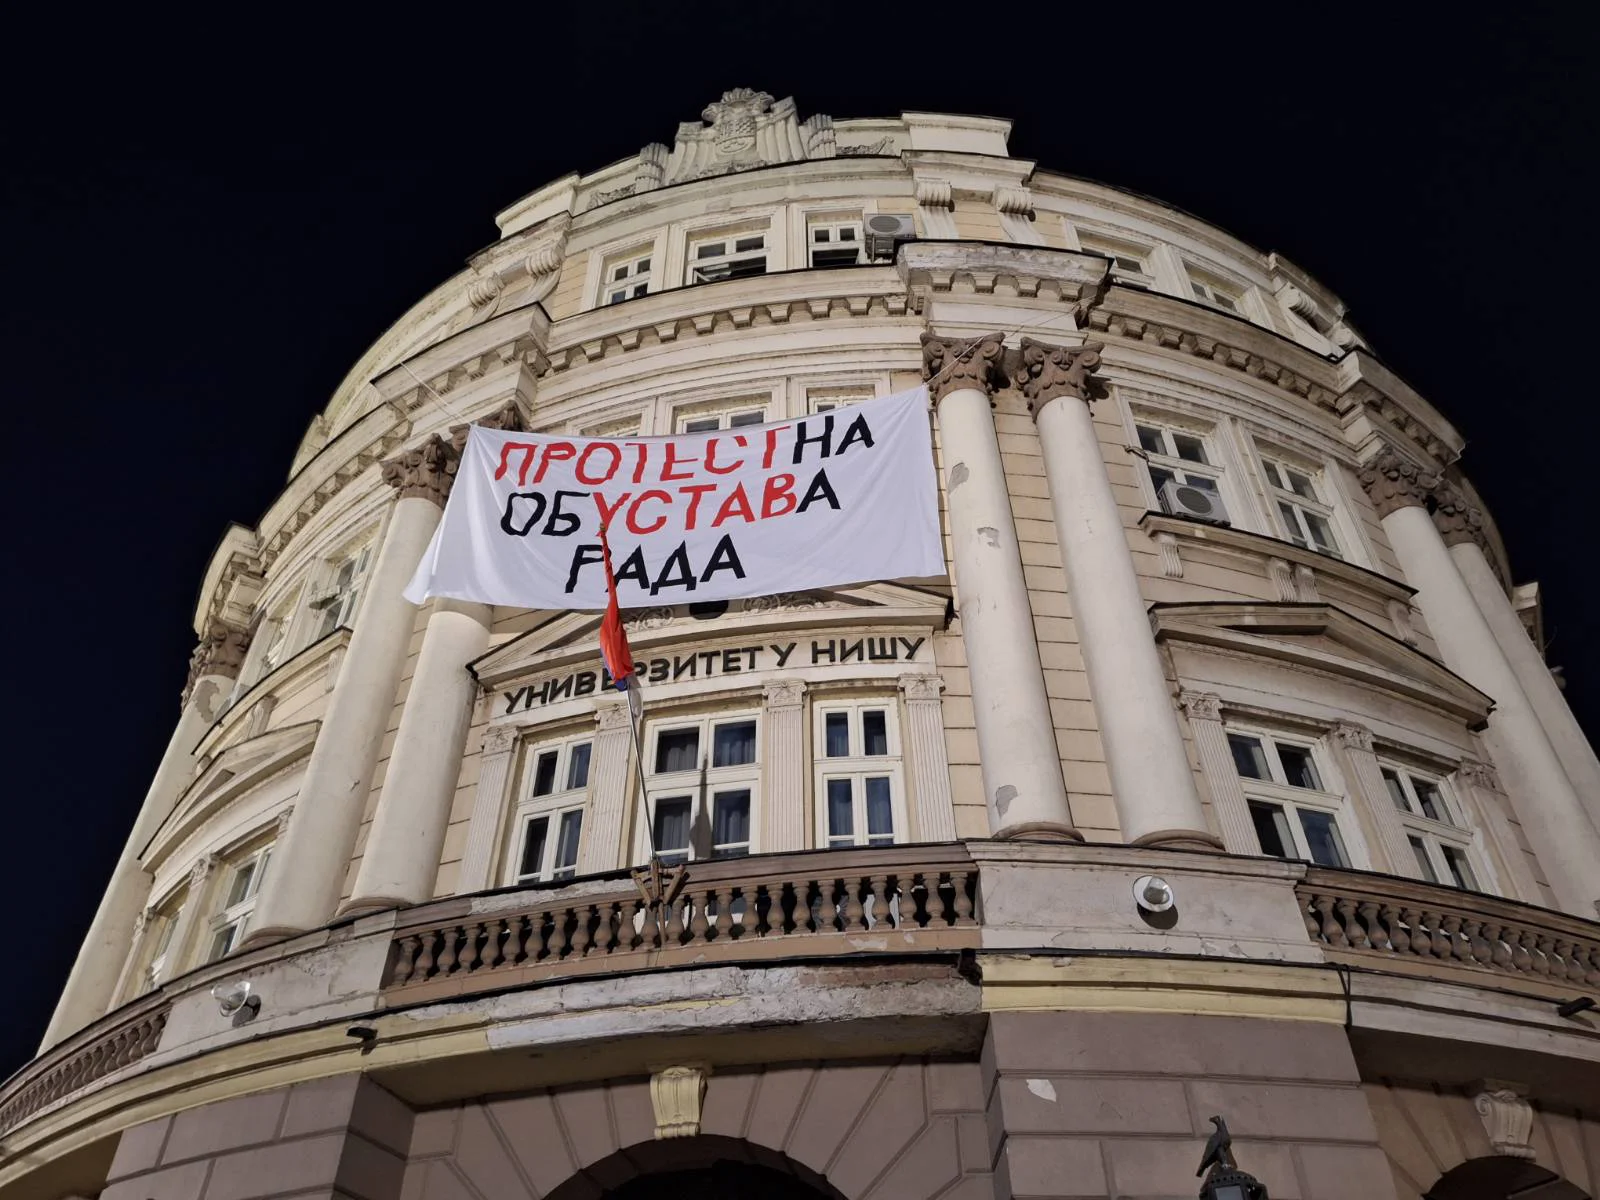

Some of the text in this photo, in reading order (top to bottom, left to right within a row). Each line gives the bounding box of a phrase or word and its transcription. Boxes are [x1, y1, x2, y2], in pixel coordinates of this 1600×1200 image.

[501, 473, 841, 537] ОБУСТАВА
[564, 533, 747, 596] РАДА
[770, 642, 798, 668] У
[811, 637, 926, 664] НИШУ
